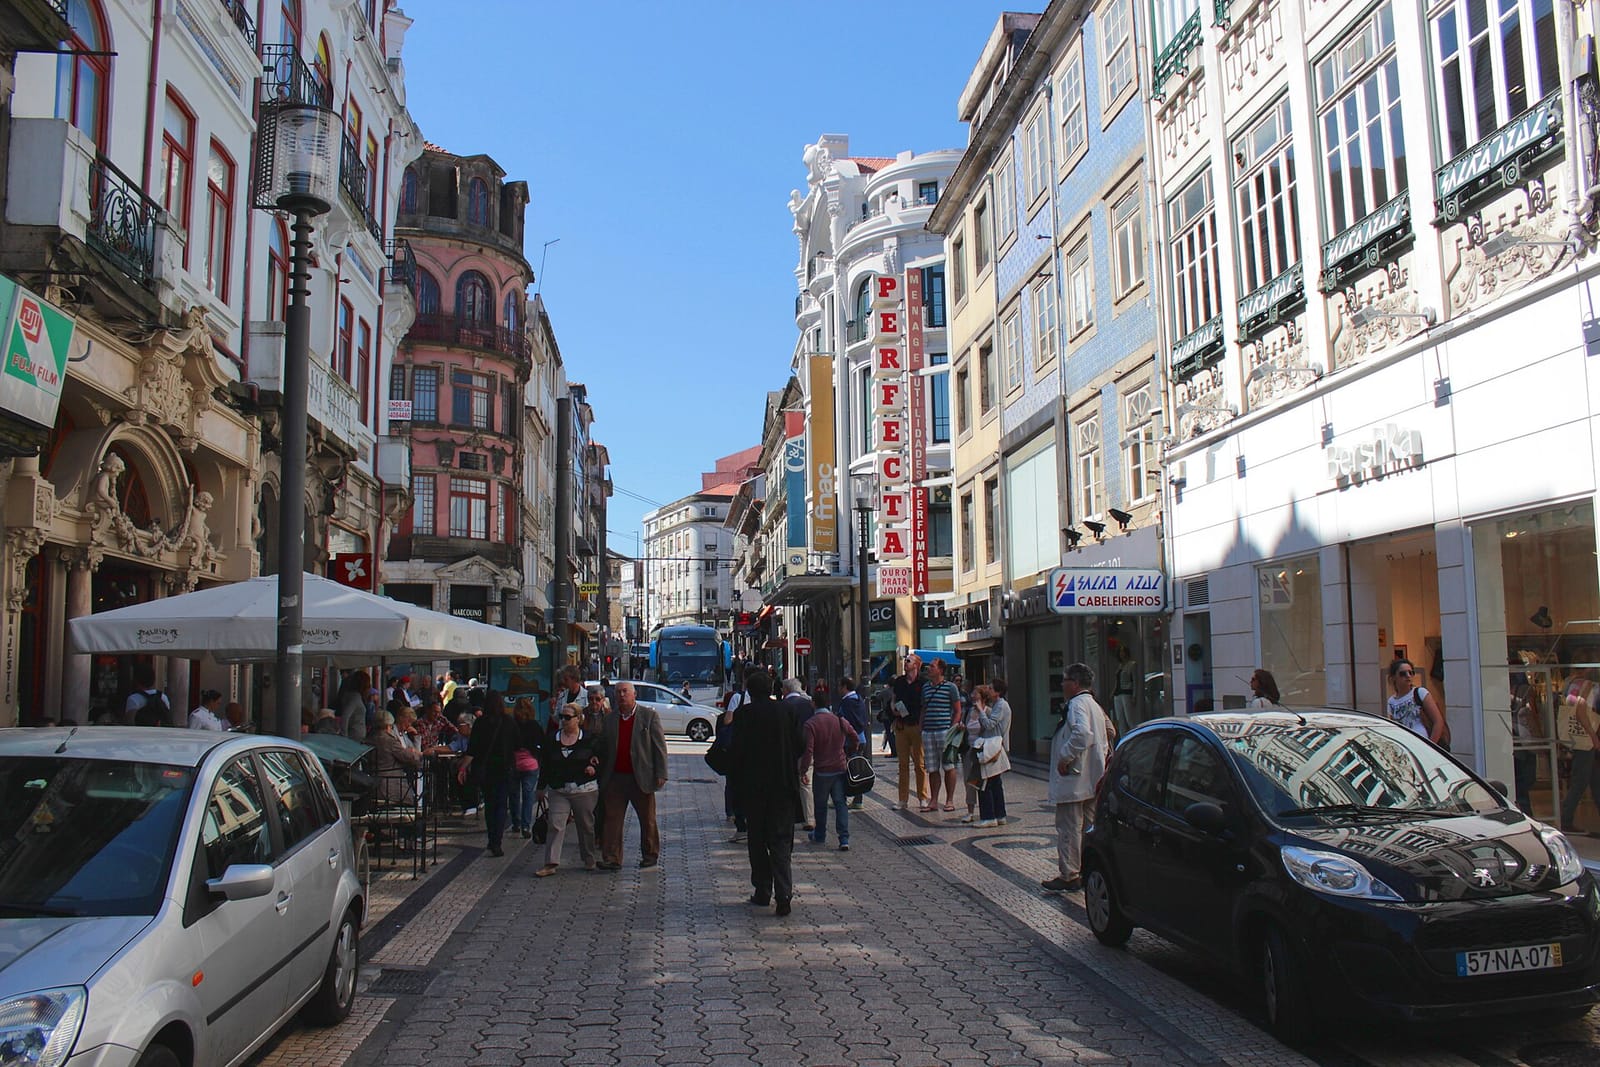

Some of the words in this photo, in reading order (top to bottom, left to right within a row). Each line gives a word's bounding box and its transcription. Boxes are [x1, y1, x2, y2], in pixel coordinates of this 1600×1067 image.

[909, 274, 921, 363] MENAGE
[12, 353, 36, 375] FUJI
[37, 365, 58, 385] FILM
[878, 277, 904, 554] PERFECTA
[913, 377, 923, 480] UTILIDADES
[785, 437, 805, 473] C&A
[1326, 422, 1424, 482] Bershka
[815, 463, 833, 520] fnac
[915, 489, 926, 593] PERFUMARIA
[882, 569, 907, 577] OURO
[882, 578, 907, 586] PRATA
[1125, 575, 1162, 590] AZUL
[882, 586, 908, 595] JOIAS
[1077, 595, 1161, 607] CABELEIREIROS
[453, 608, 482, 617] MARCOLINO
